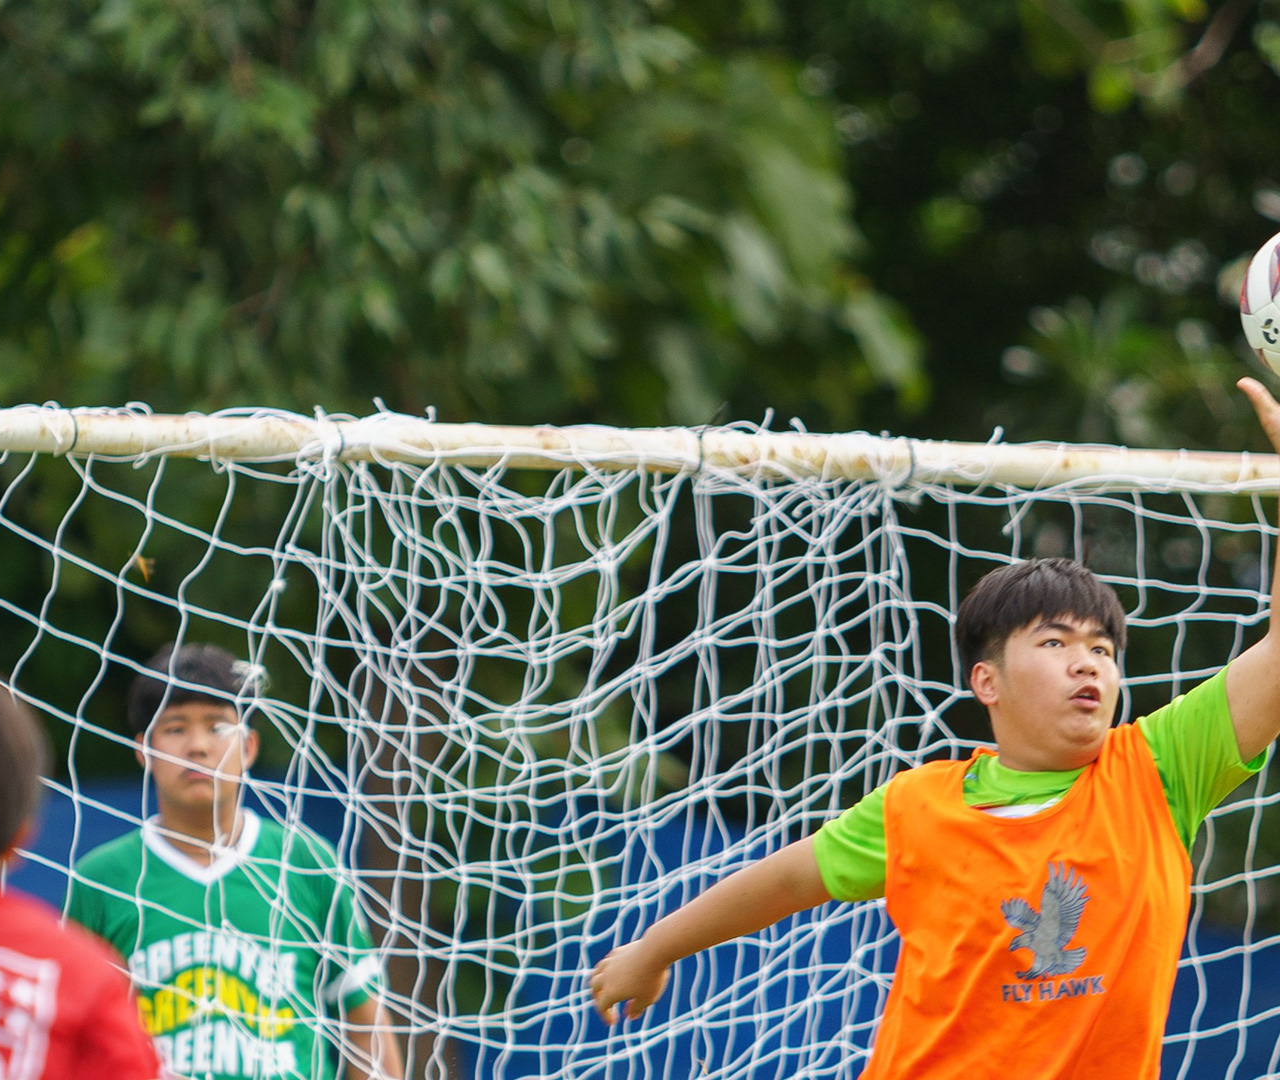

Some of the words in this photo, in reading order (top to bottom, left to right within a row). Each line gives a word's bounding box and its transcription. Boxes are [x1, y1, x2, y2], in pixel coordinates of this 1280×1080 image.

[127, 930, 297, 1000] GREENYER
[1001, 983, 1033, 1002] FLY
[1037, 975, 1106, 1001] HAWK
[152, 1020, 297, 1078] REENYER
